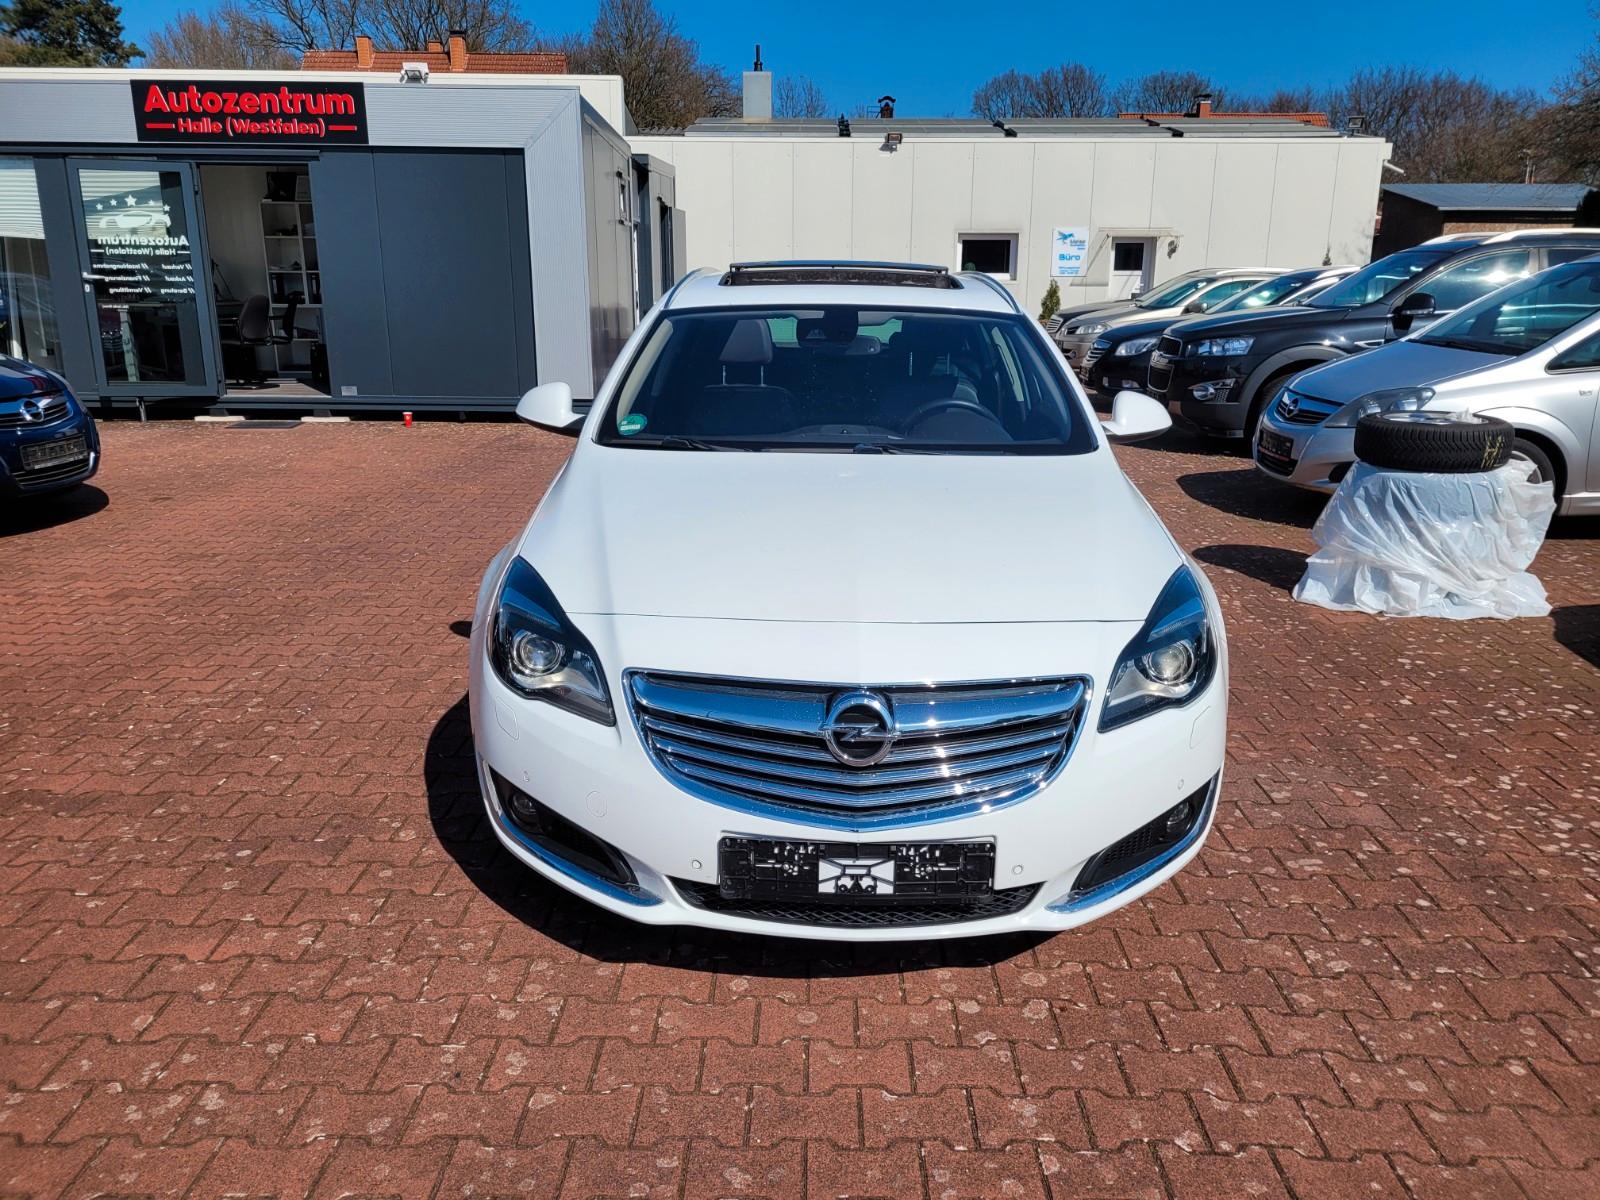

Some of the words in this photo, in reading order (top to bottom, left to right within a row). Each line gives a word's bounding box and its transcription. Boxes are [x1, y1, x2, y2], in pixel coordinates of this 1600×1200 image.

[144, 84, 356, 115] Autozentrum
[177, 117, 222, 134] Halle
[225, 117, 326, 138] (Westfalen)
[1059, 253, 1081, 261] Büro
